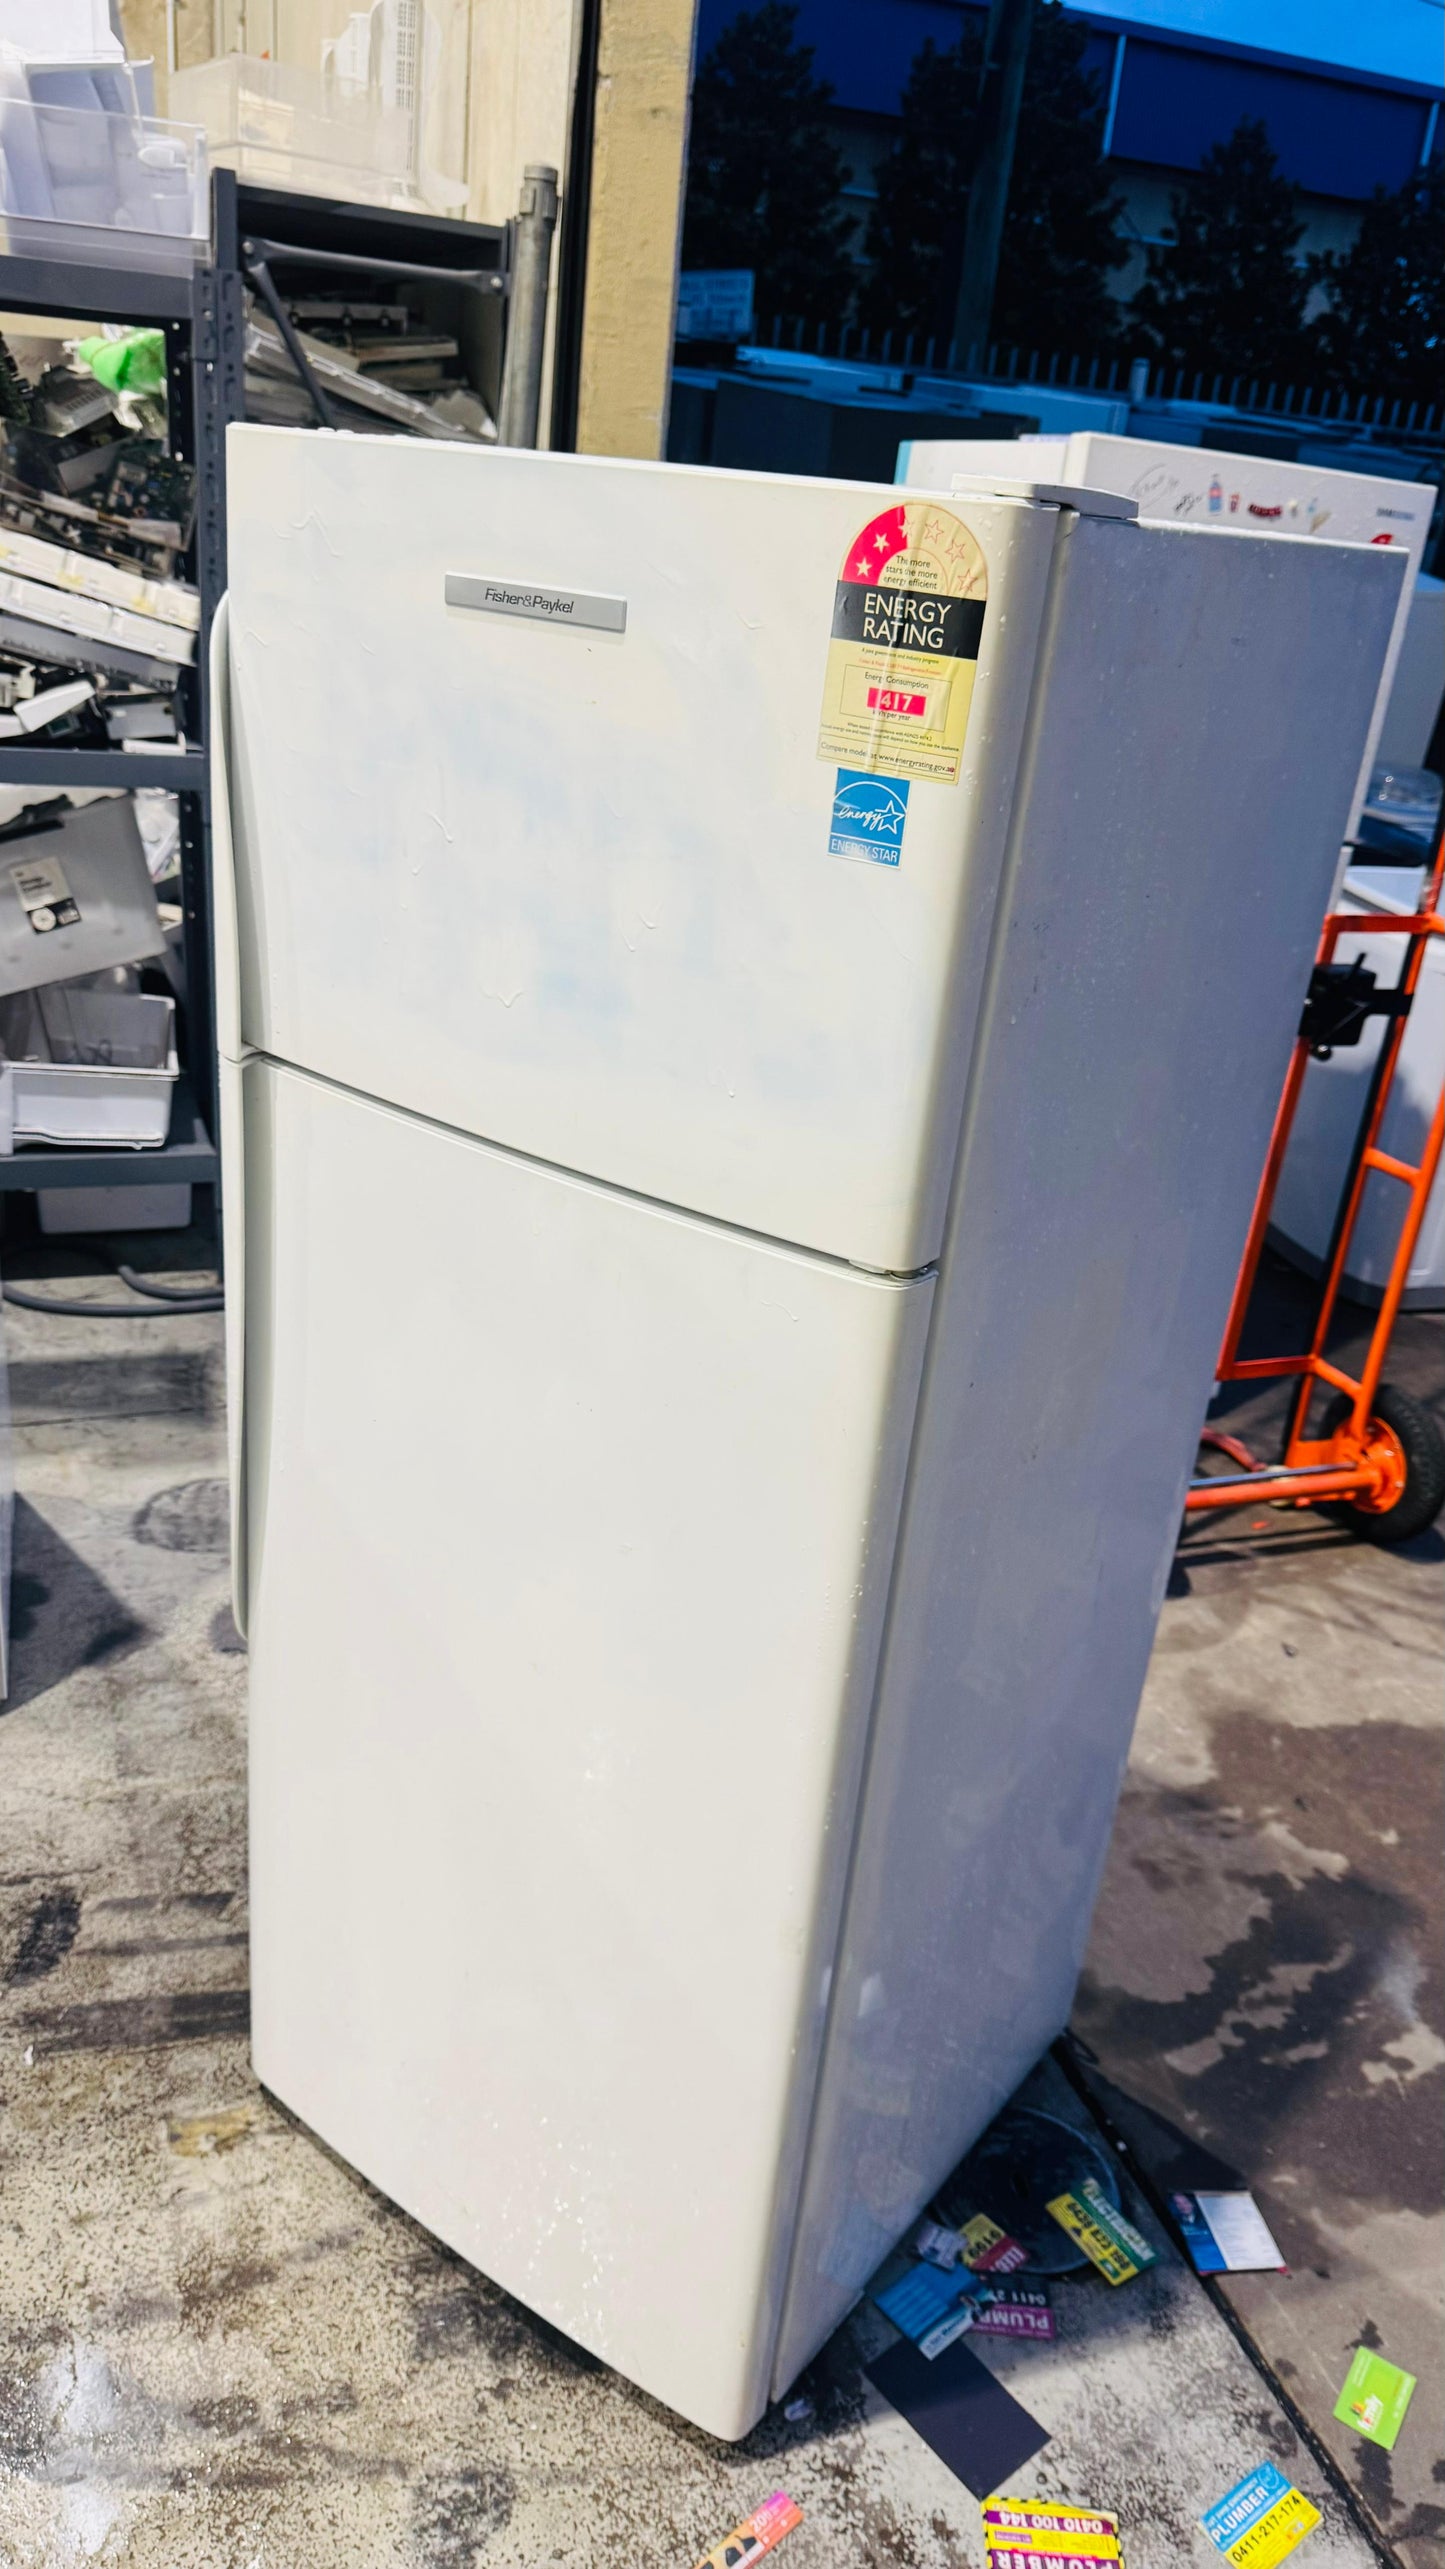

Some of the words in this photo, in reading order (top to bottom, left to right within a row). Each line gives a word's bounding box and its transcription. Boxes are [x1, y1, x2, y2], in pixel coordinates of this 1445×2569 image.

[886, 566, 903, 575] stars
[918, 571, 938, 580] more
[909, 560, 931, 569] more
[908, 578, 937, 589] efficient
[864, 592, 952, 625] ENERGY
[863, 617, 945, 649] RATING
[864, 671, 884, 684] Energ
[886, 675, 929, 690] Consumption
[881, 692, 913, 712] 417
[887, 711, 898, 720] per
[821, 741, 849, 754] Compare
[837, 806, 885, 830] energy
[831, 838, 871, 858] ENERGY
[871, 847, 899, 863] STAR
[998, 2511, 1028, 2528] 144
[1031, 2514, 1060, 2530] 100
[1210, 2485, 1270, 2543] PLUMBER
[1063, 2518, 1104, 2534] 0410
[1232, 2494, 1301, 2563] 0411-217-174
